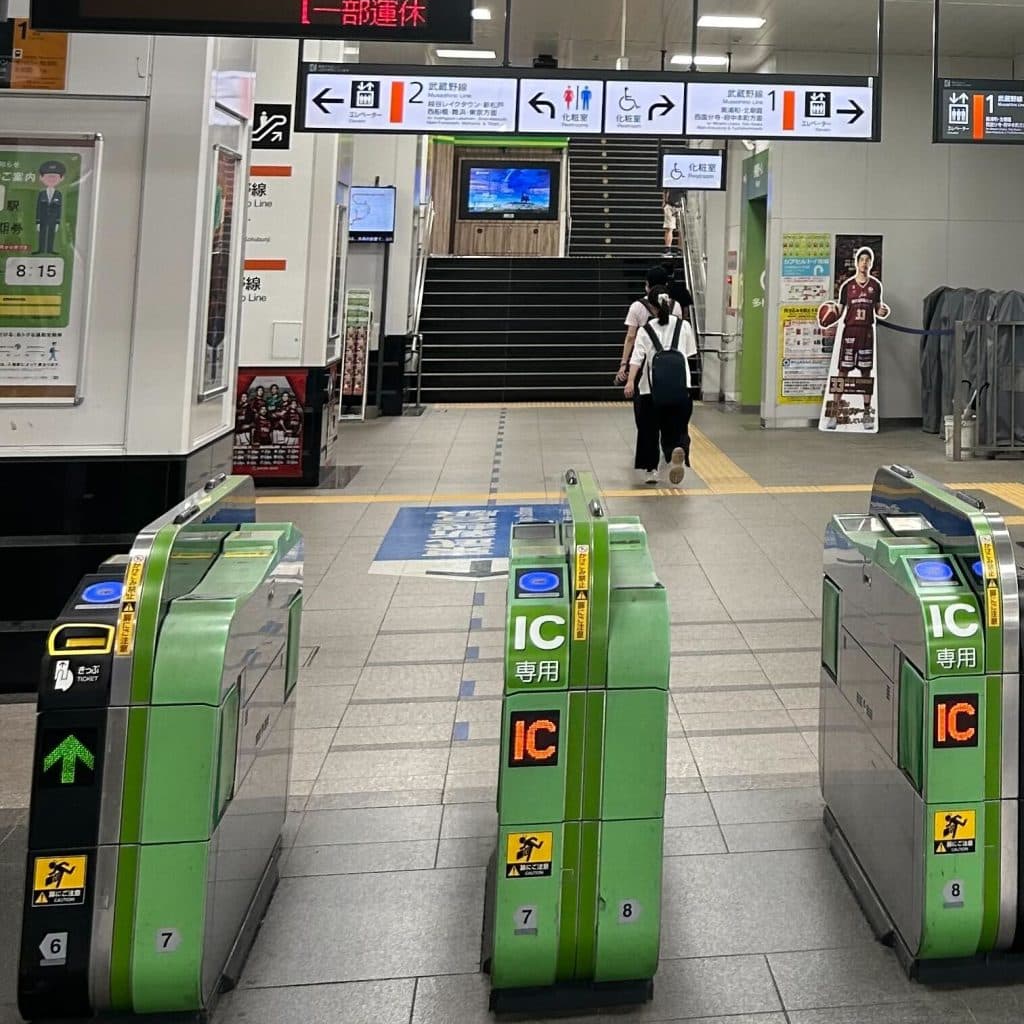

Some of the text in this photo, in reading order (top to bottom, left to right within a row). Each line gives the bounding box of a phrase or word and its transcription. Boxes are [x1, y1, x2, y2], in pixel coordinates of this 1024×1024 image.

[18, 21, 28, 40] 1
[408, 81, 423, 103] 2
[768, 90, 776, 112] 1
[986, 94, 994, 114] 1
[254, 200, 272, 208] Line
[248, 294, 267, 302] Line
[929, 603, 979, 638] IC
[514, 615, 565, 650] IC
[936, 647, 976, 669] 専用
[77, 665, 100, 675] きっぷ
[515, 660, 559, 683] 専用
[937, 702, 976, 742] IC
[514, 719, 556, 760] IC
[952, 883, 960, 896] 8
[522, 909, 532, 924] 7
[622, 903, 632, 917] 8
[50, 938, 61, 954] 6
[161, 933, 172, 948] 7
